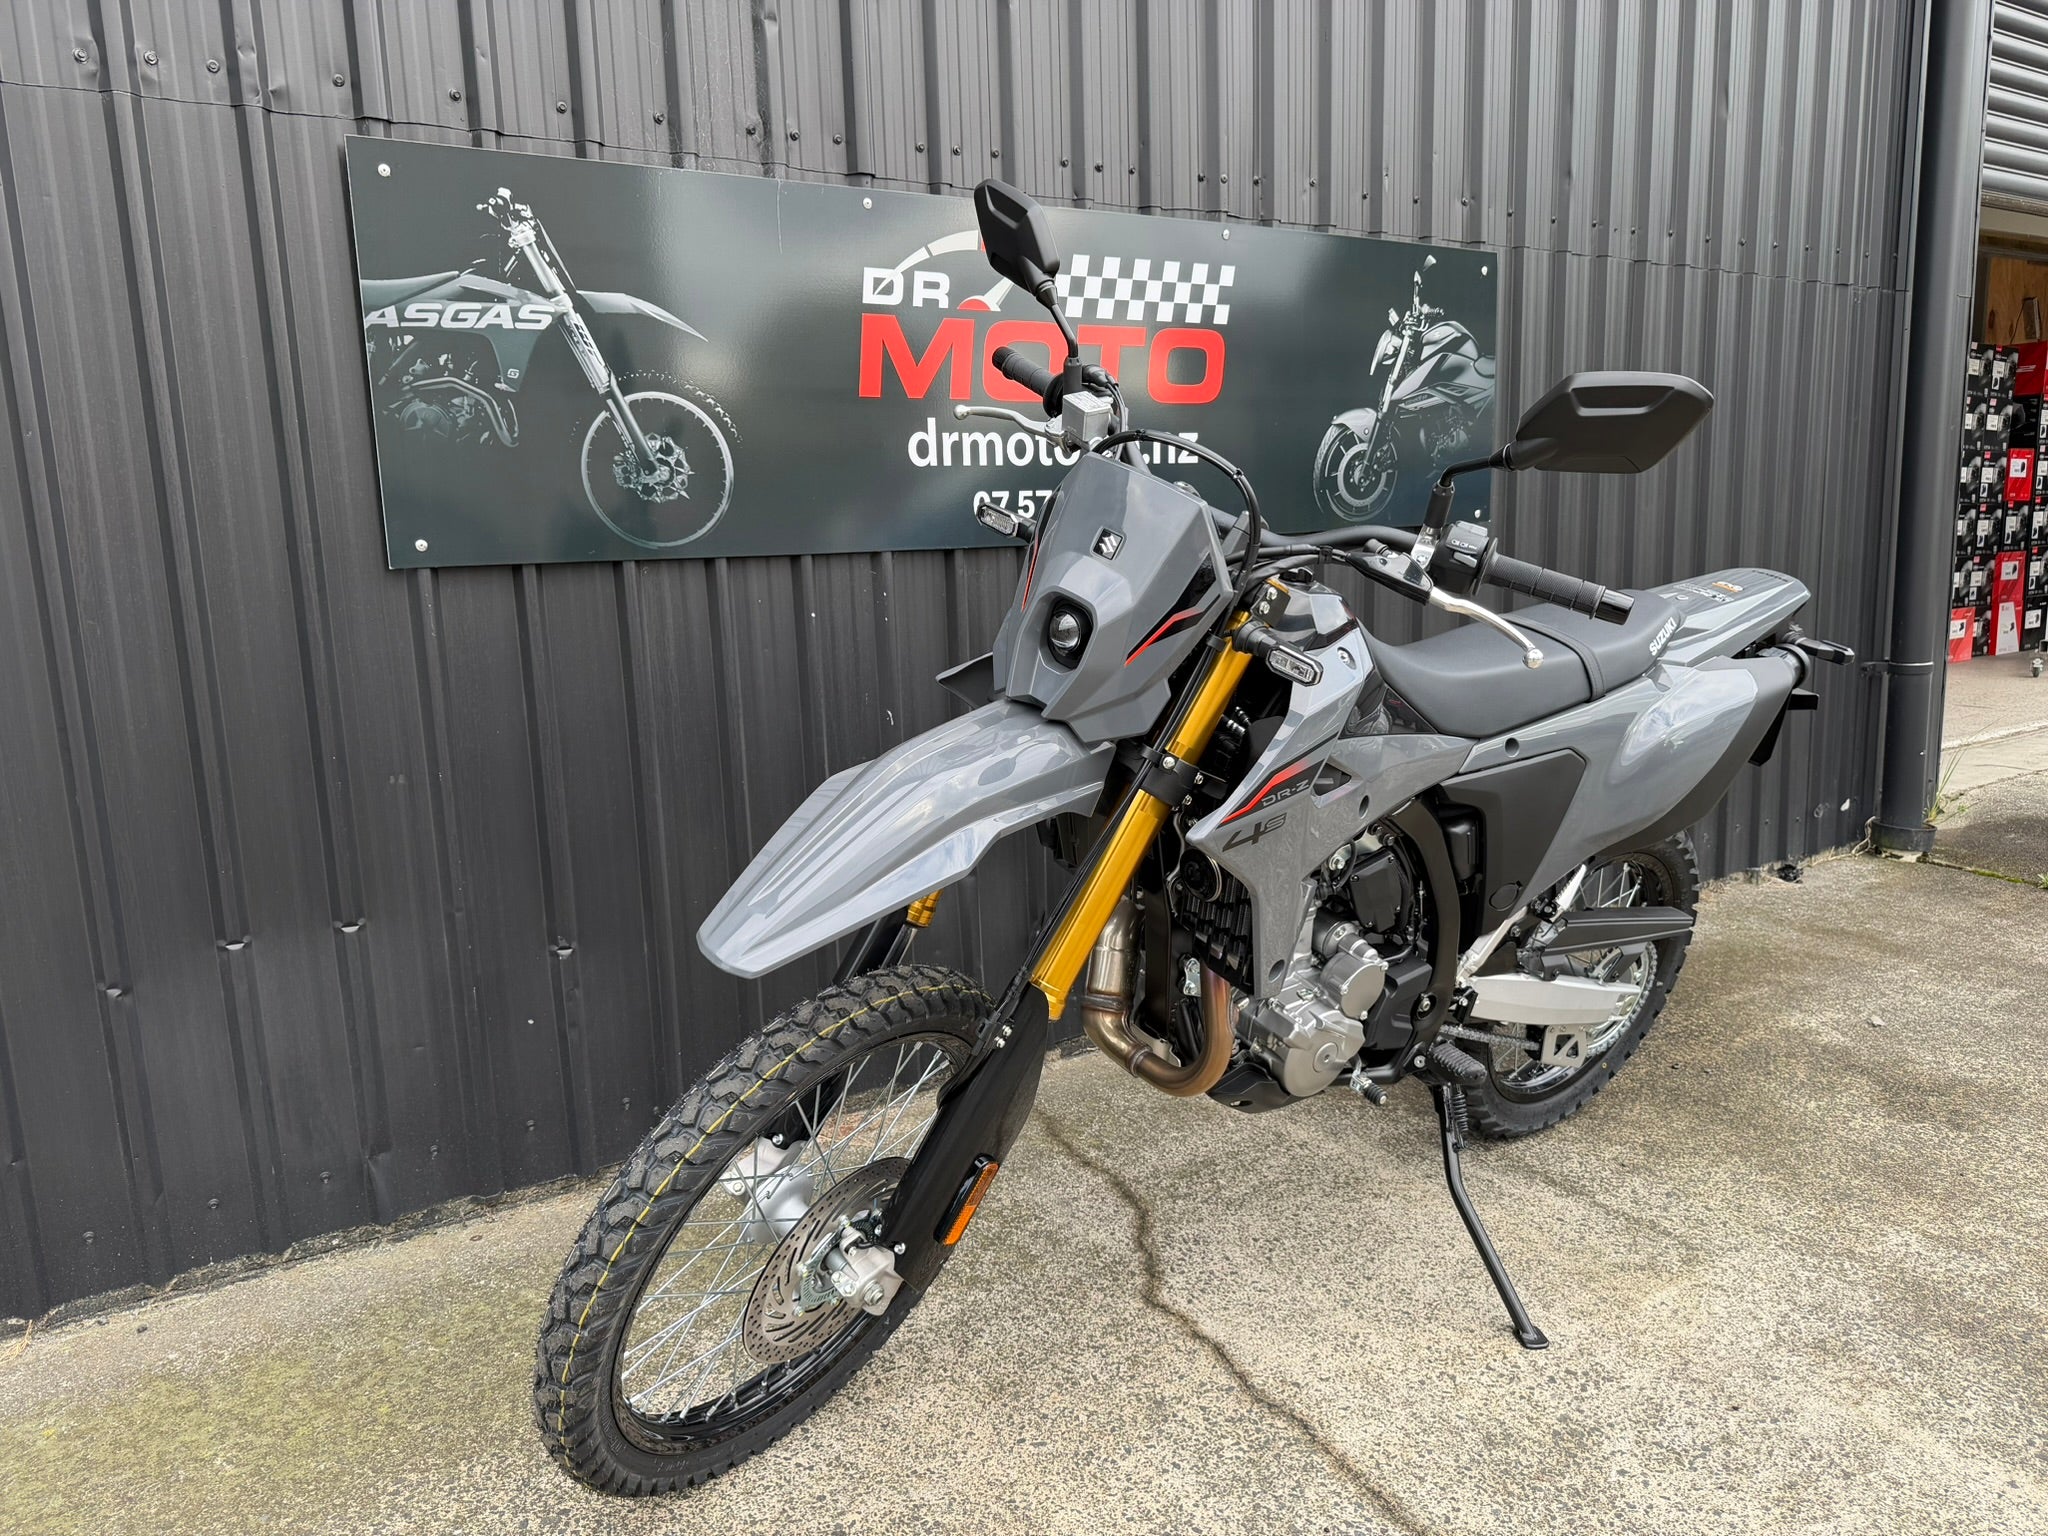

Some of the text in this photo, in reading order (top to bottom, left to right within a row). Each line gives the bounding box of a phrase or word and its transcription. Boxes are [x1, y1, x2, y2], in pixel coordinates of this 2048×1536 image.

[862, 266, 950, 309] DR
[858, 312, 1226, 405] MOTO
[1649, 616, 1677, 656] SUZUKI
[1262, 780, 1310, 807] DR-Z
